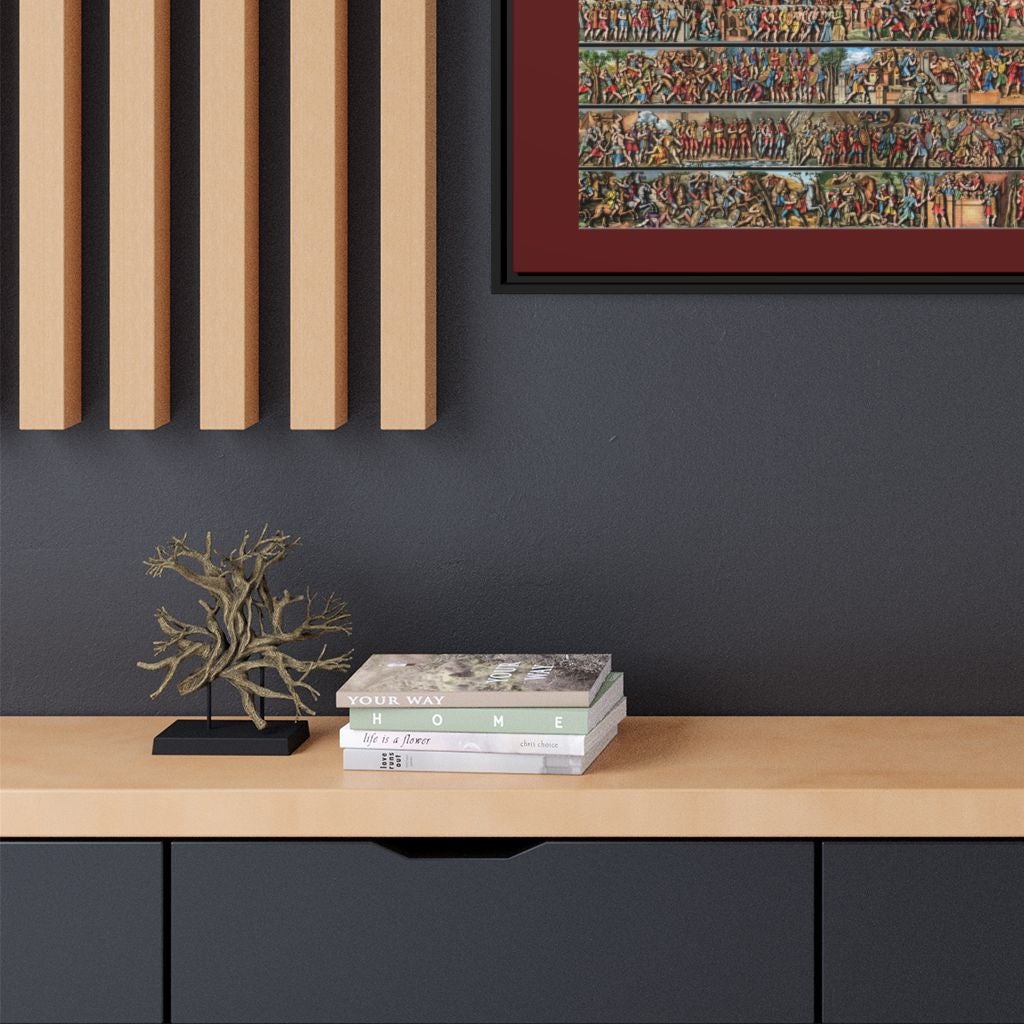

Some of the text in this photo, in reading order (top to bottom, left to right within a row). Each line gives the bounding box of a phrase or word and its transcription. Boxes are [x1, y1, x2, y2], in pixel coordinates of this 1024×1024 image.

[347, 695, 445, 705] YOUR WAY
[372, 712, 563, 729] HOME
[363, 733, 379, 747] life
[382, 734, 390, 744] is
[400, 734, 432, 748] flower
[520, 739, 559, 749] chris choice
[380, 753, 388, 769] love
